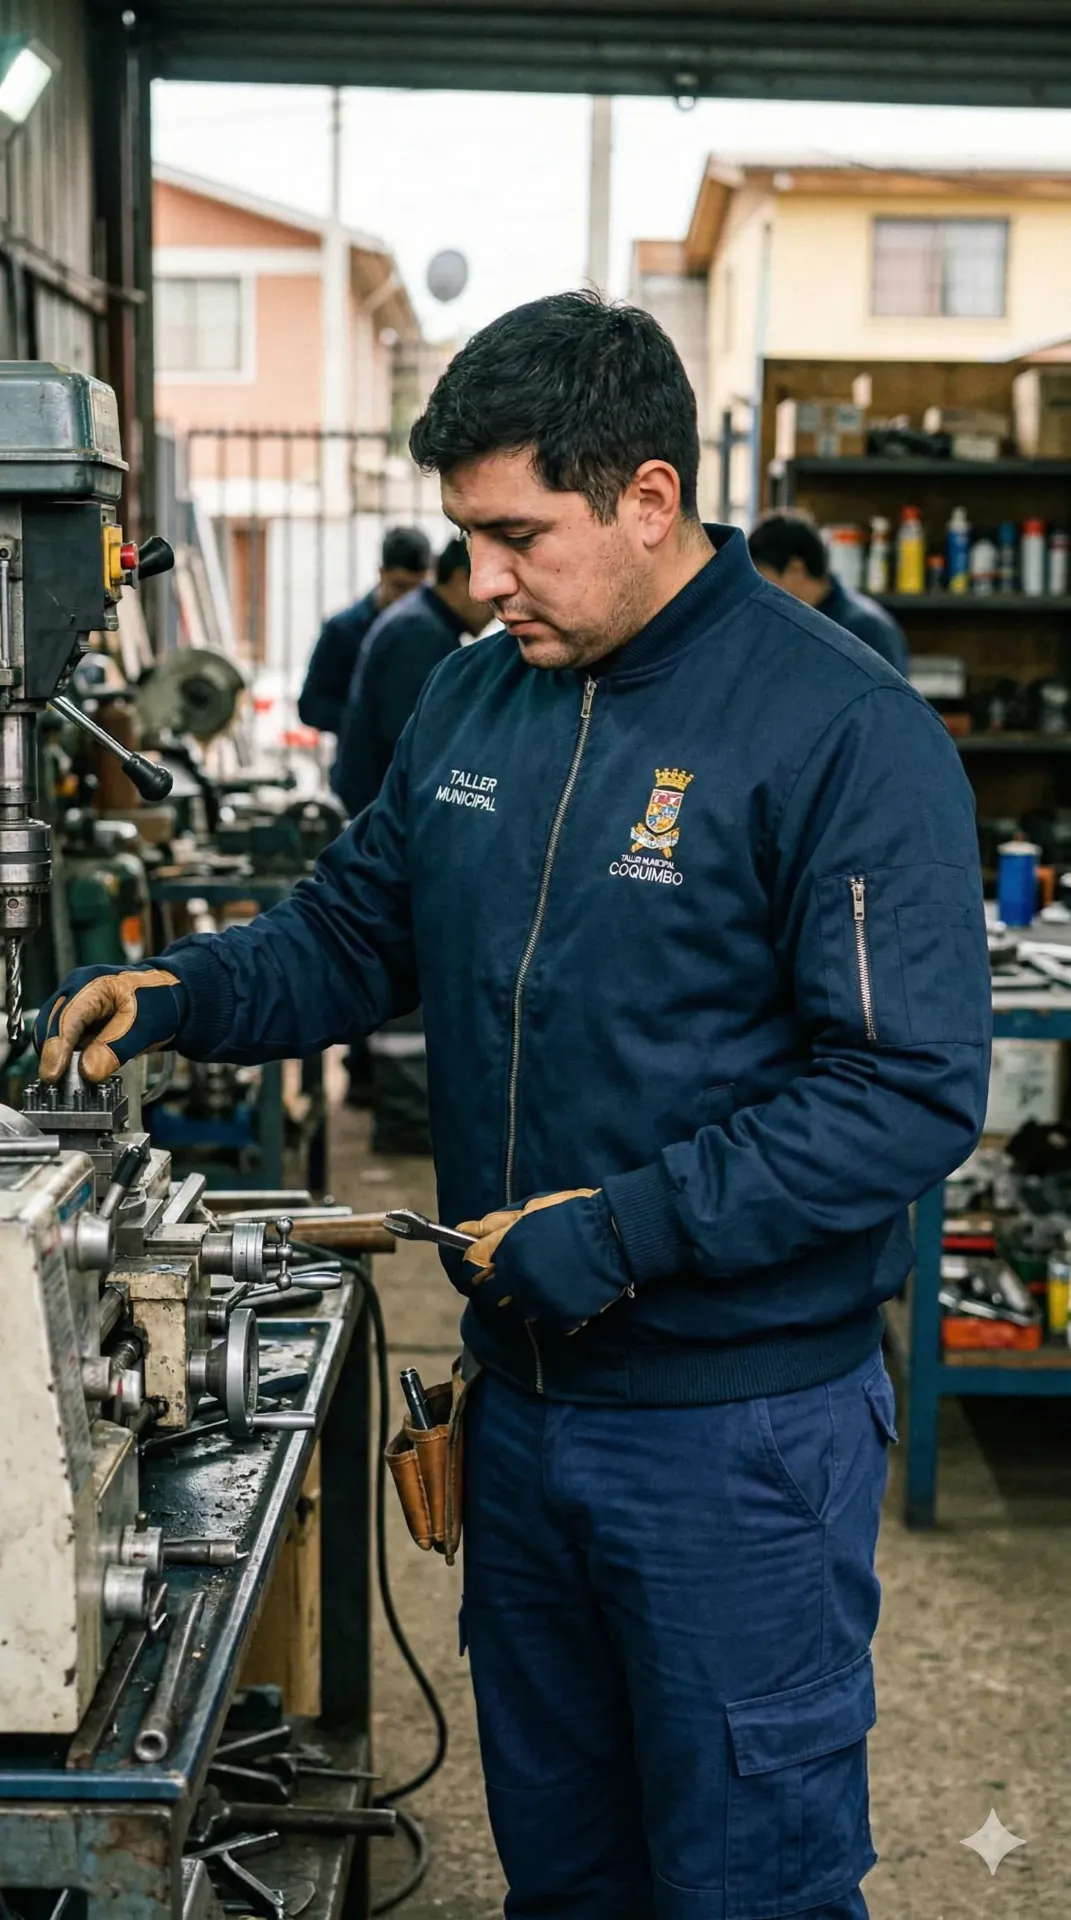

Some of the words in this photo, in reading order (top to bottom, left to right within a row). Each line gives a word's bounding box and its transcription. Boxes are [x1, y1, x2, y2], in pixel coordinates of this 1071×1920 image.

[450, 769, 498, 793] TALLER
[435, 785, 496, 812] MUNICIPAL
[609, 862, 683, 886] COQUIMBO
